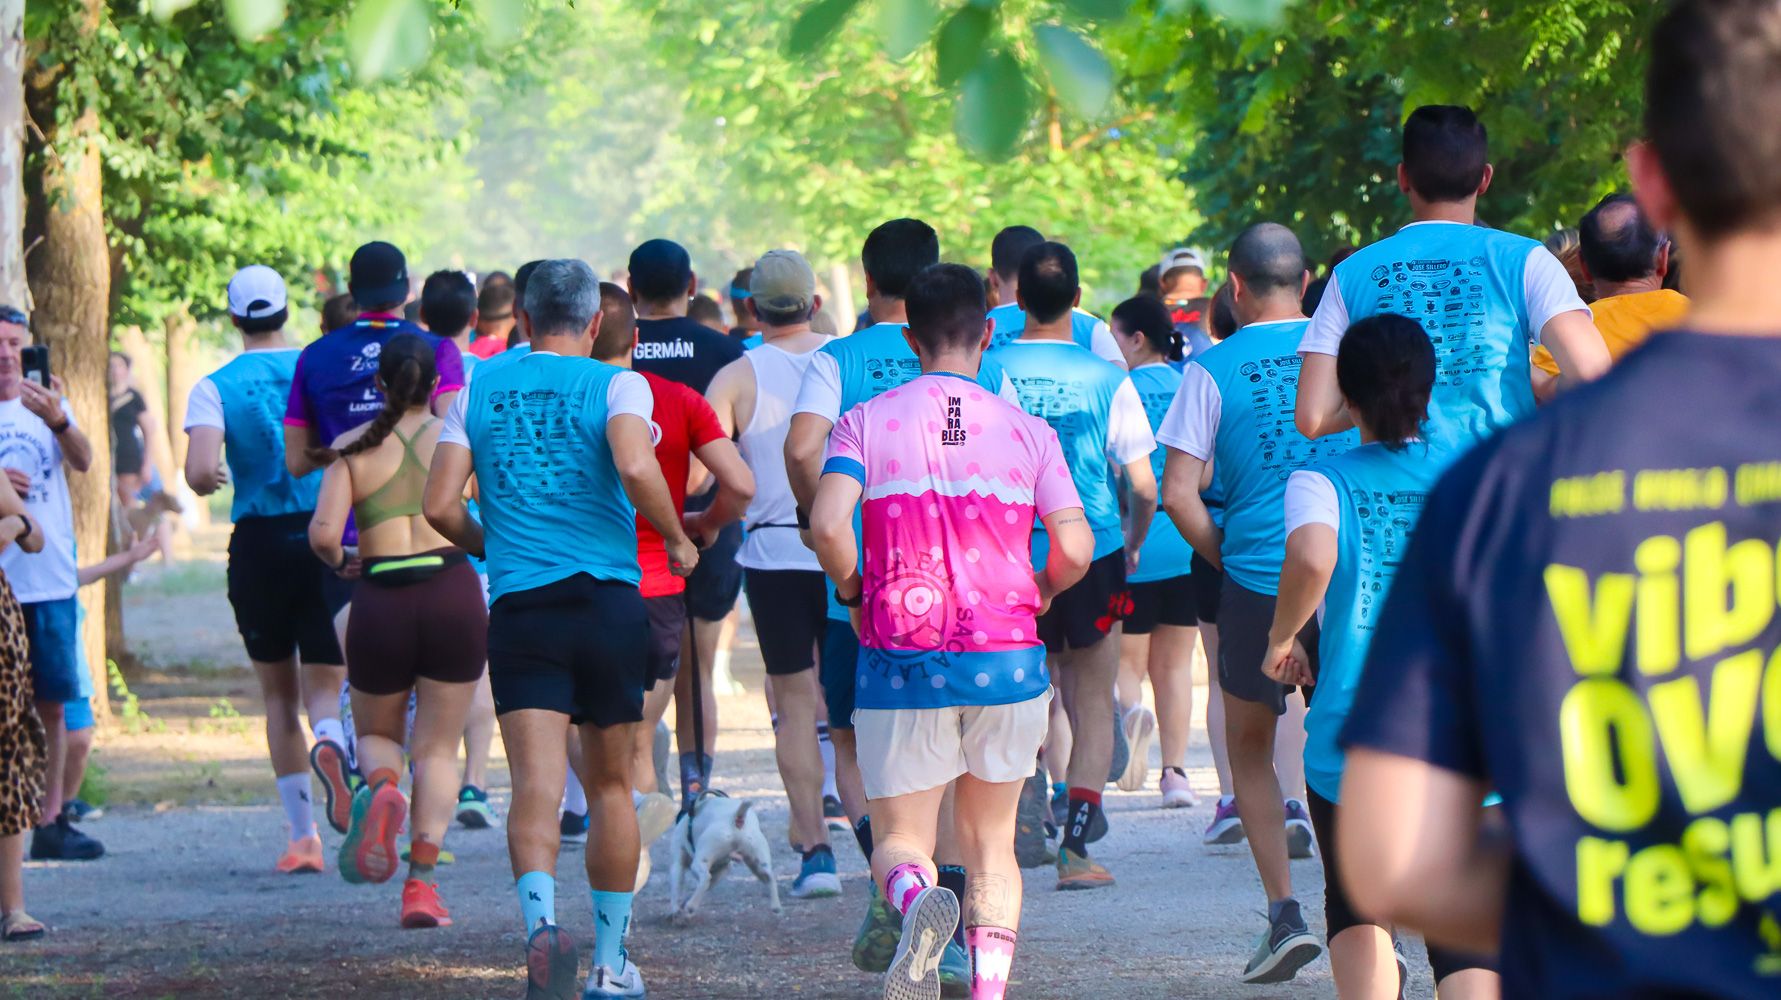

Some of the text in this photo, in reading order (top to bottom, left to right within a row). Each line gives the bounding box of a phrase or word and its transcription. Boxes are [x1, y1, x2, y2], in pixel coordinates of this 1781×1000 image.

[1426, 262, 1447, 271] SILLERO
[634, 338, 694, 359] GERMÁN
[349, 402, 386, 412] Lucen
[942, 430, 966, 441] BLES
[1543, 521, 1781, 676] vib
[931, 607, 974, 669] SACA
[1559, 643, 1781, 833] ov
